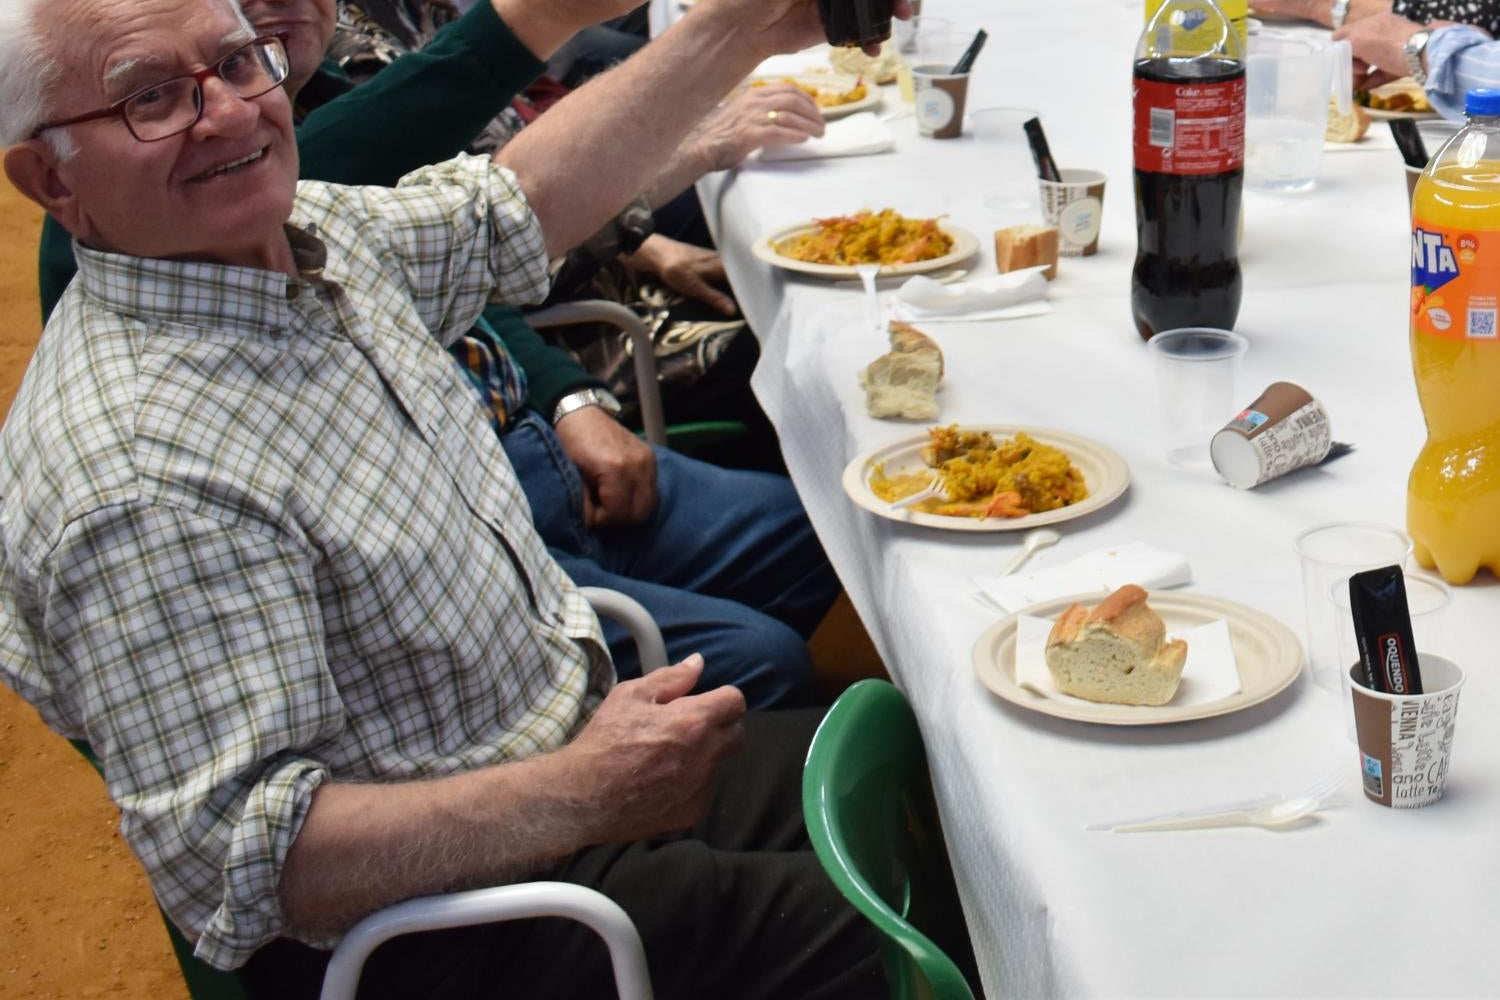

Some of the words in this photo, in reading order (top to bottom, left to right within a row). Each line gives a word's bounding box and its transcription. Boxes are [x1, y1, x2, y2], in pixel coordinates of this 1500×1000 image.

[1387, 637, 1404, 693] OQUENDO
[1400, 701, 1420, 740] VIENNA
[1393, 773, 1424, 785] ano
[1396, 784, 1424, 799] latte
